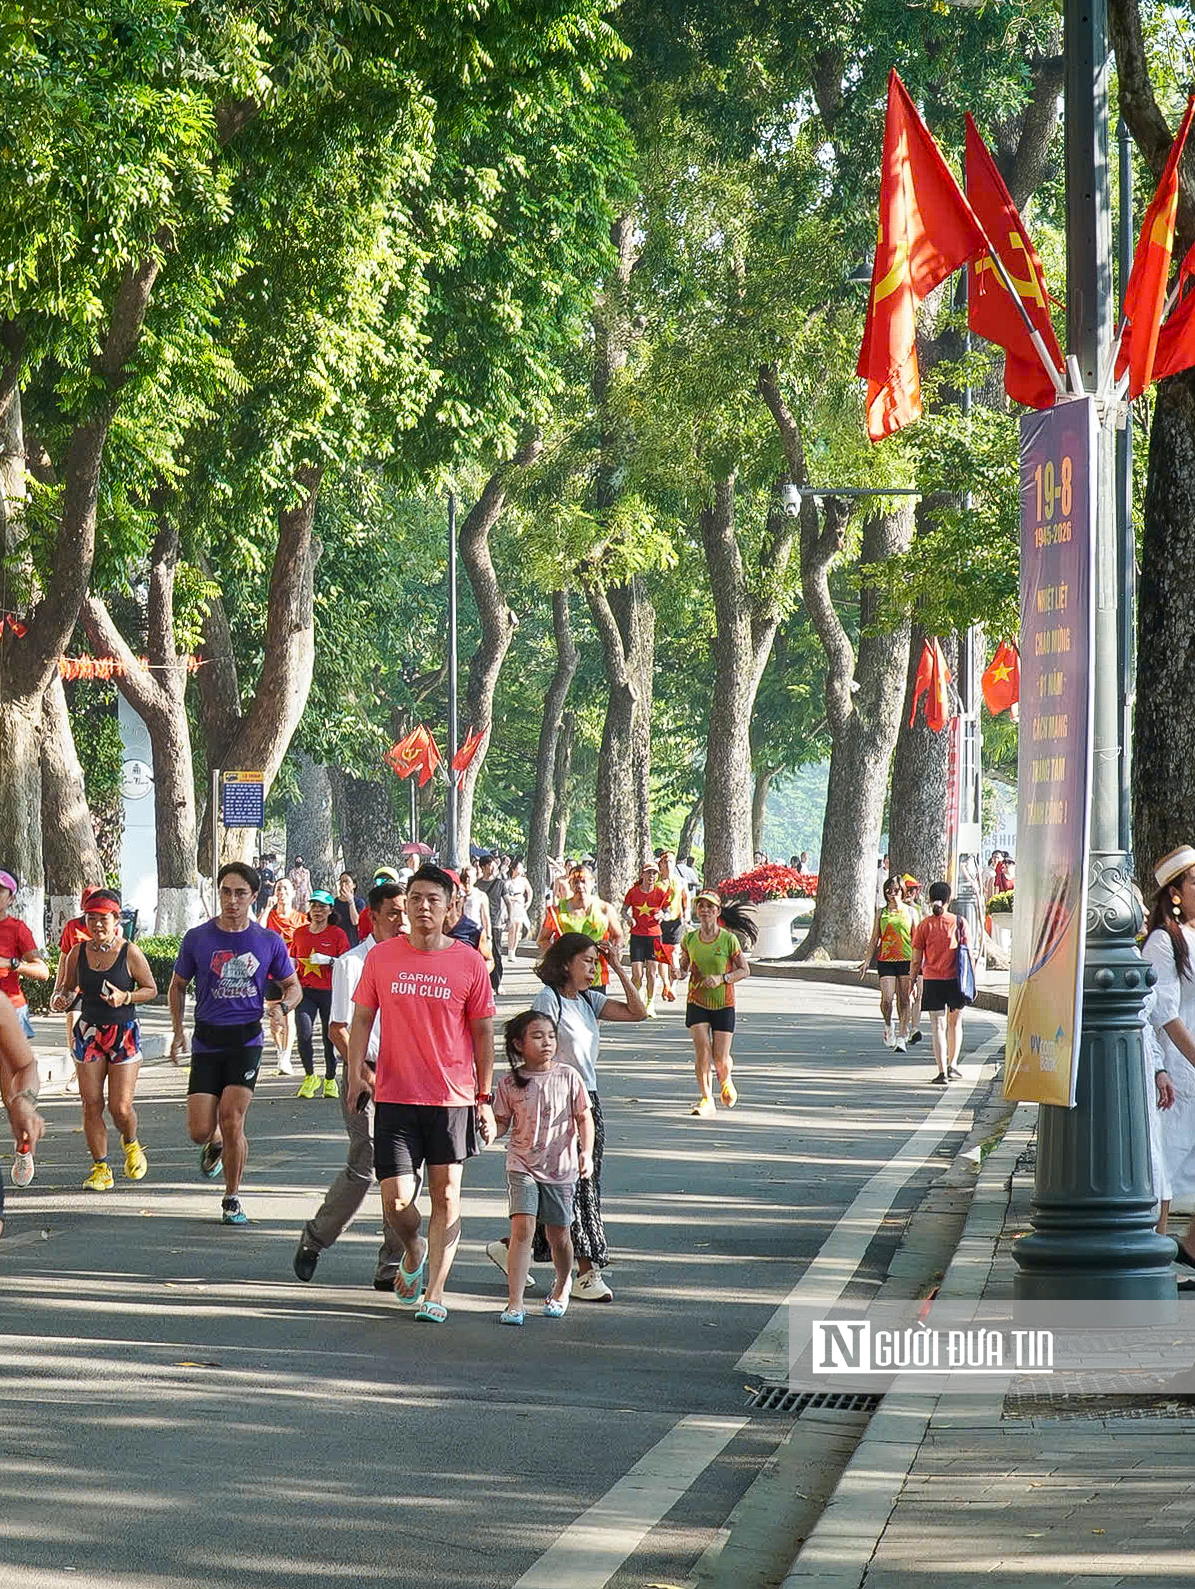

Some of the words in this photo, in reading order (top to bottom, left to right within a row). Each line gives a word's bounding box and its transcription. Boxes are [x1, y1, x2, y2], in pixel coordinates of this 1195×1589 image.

[1035, 456, 1072, 522] 19-8
[398, 971, 448, 985] GARMIN
[391, 982, 417, 995] RUN
[419, 984, 452, 1000] CLUB
